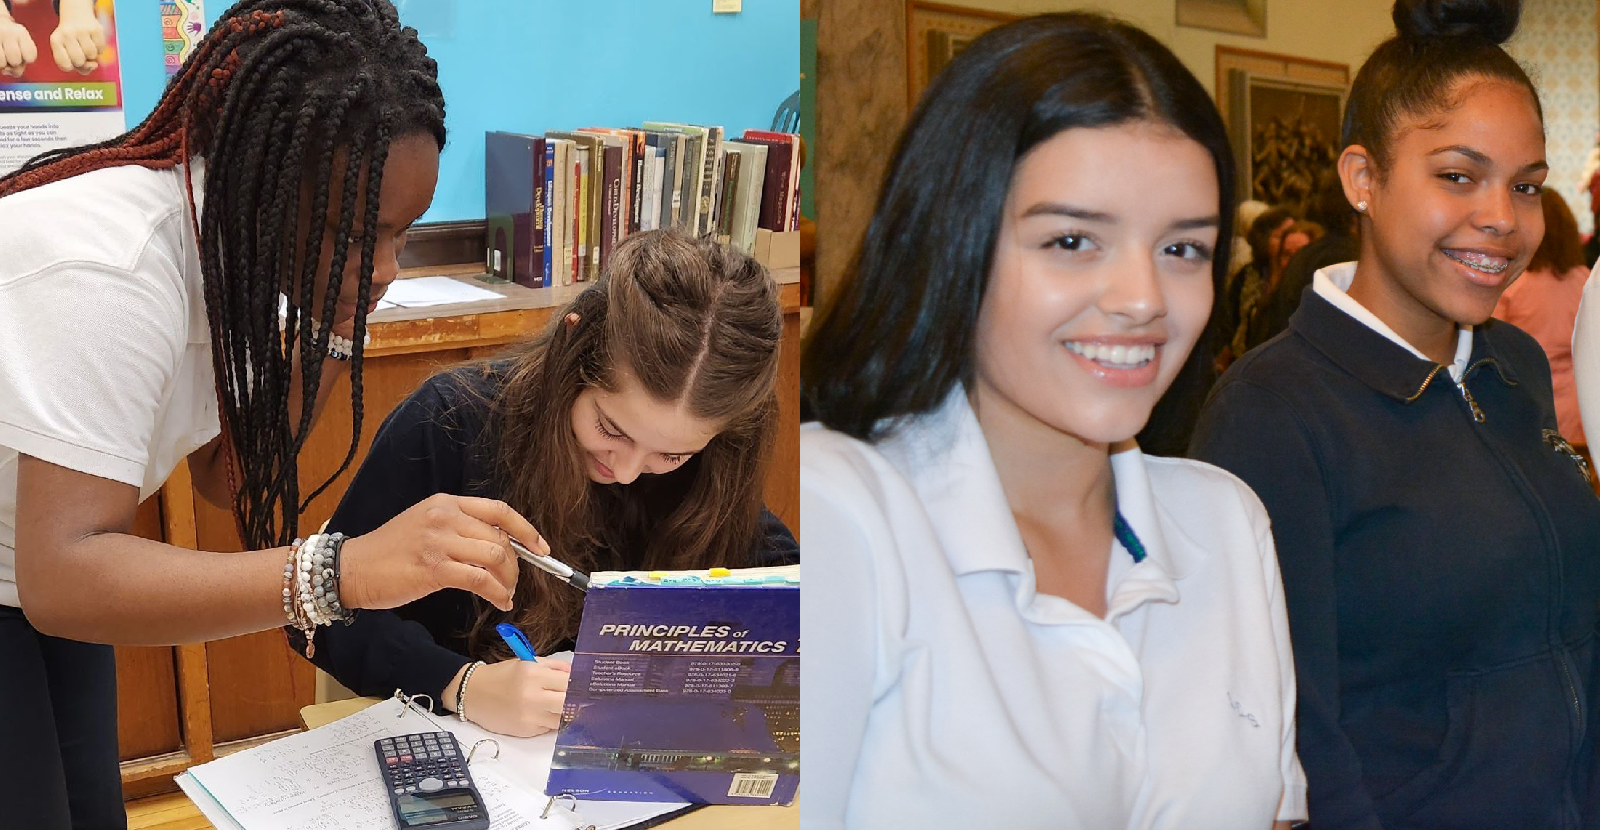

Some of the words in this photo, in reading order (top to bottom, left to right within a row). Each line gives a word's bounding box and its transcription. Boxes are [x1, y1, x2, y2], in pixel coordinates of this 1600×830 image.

[34, 87, 62, 100] and
[65, 87, 104, 100] Relax
[599, 624, 731, 638] PRINCIPLES
[732, 628, 749, 639] of
[628, 639, 787, 654] MATHEMATICS
